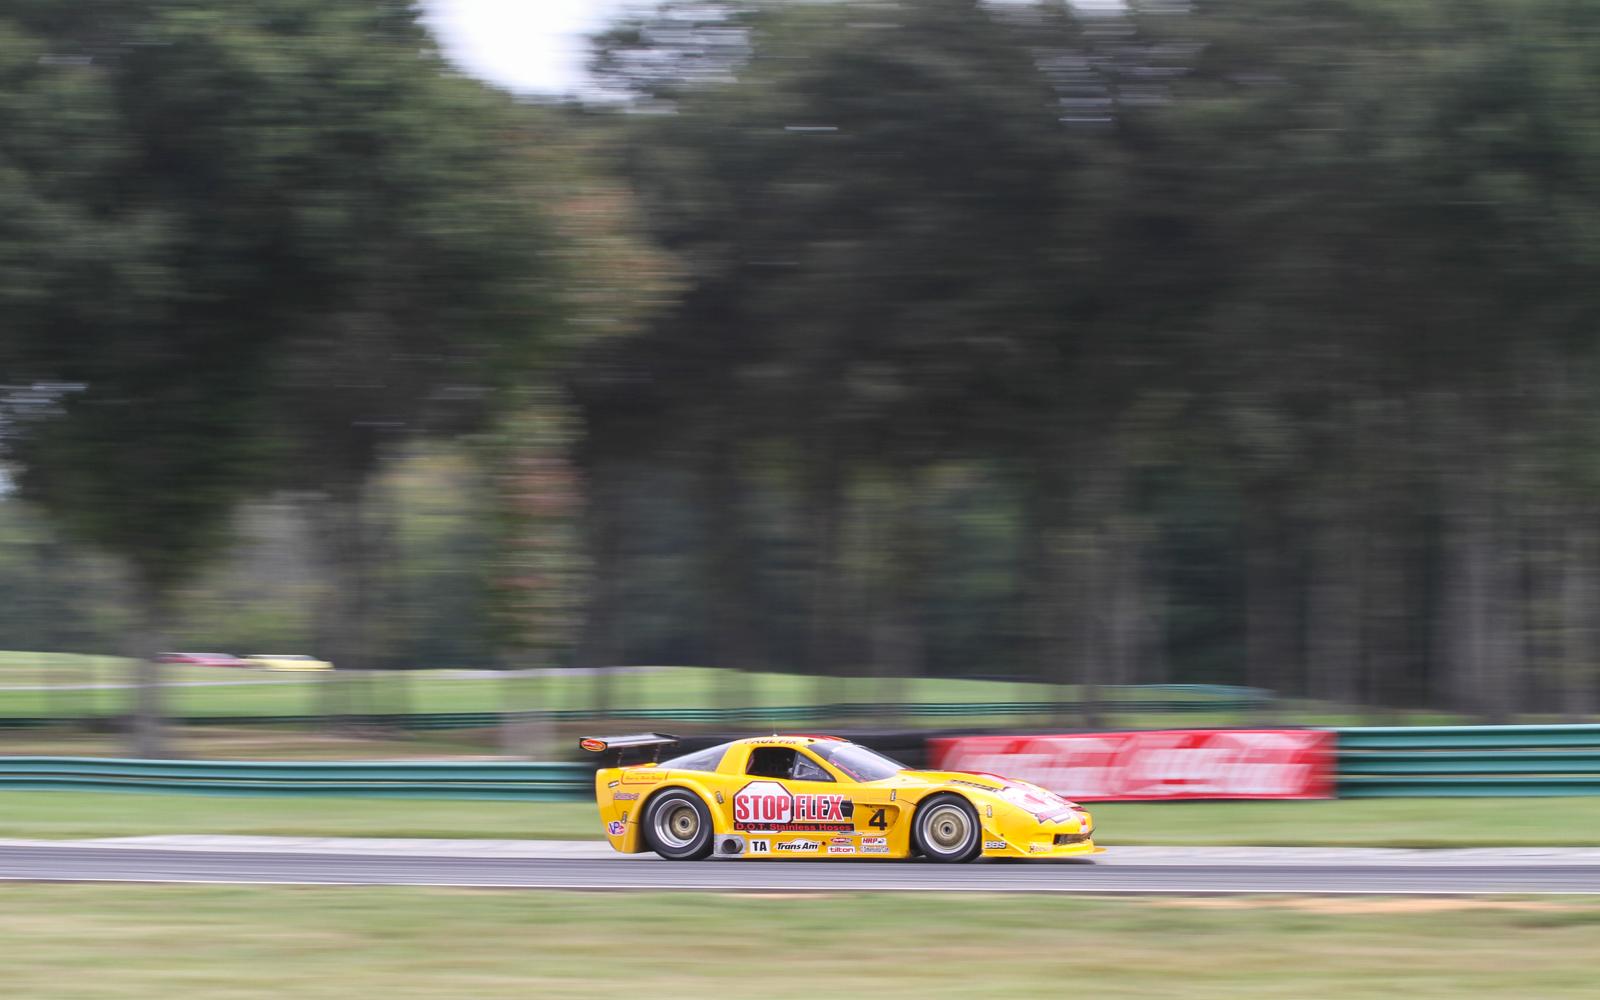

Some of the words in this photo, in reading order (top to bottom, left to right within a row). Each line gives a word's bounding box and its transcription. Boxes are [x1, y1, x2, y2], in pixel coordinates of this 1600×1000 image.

[736, 795, 790, 820] STOP
[795, 795, 843, 820] FLEX
[868, 808, 888, 831] 4
[608, 821, 620, 834] VP
[752, 841, 767, 851] TA
[777, 842, 801, 850] Trans
[802, 842, 818, 850] Am
